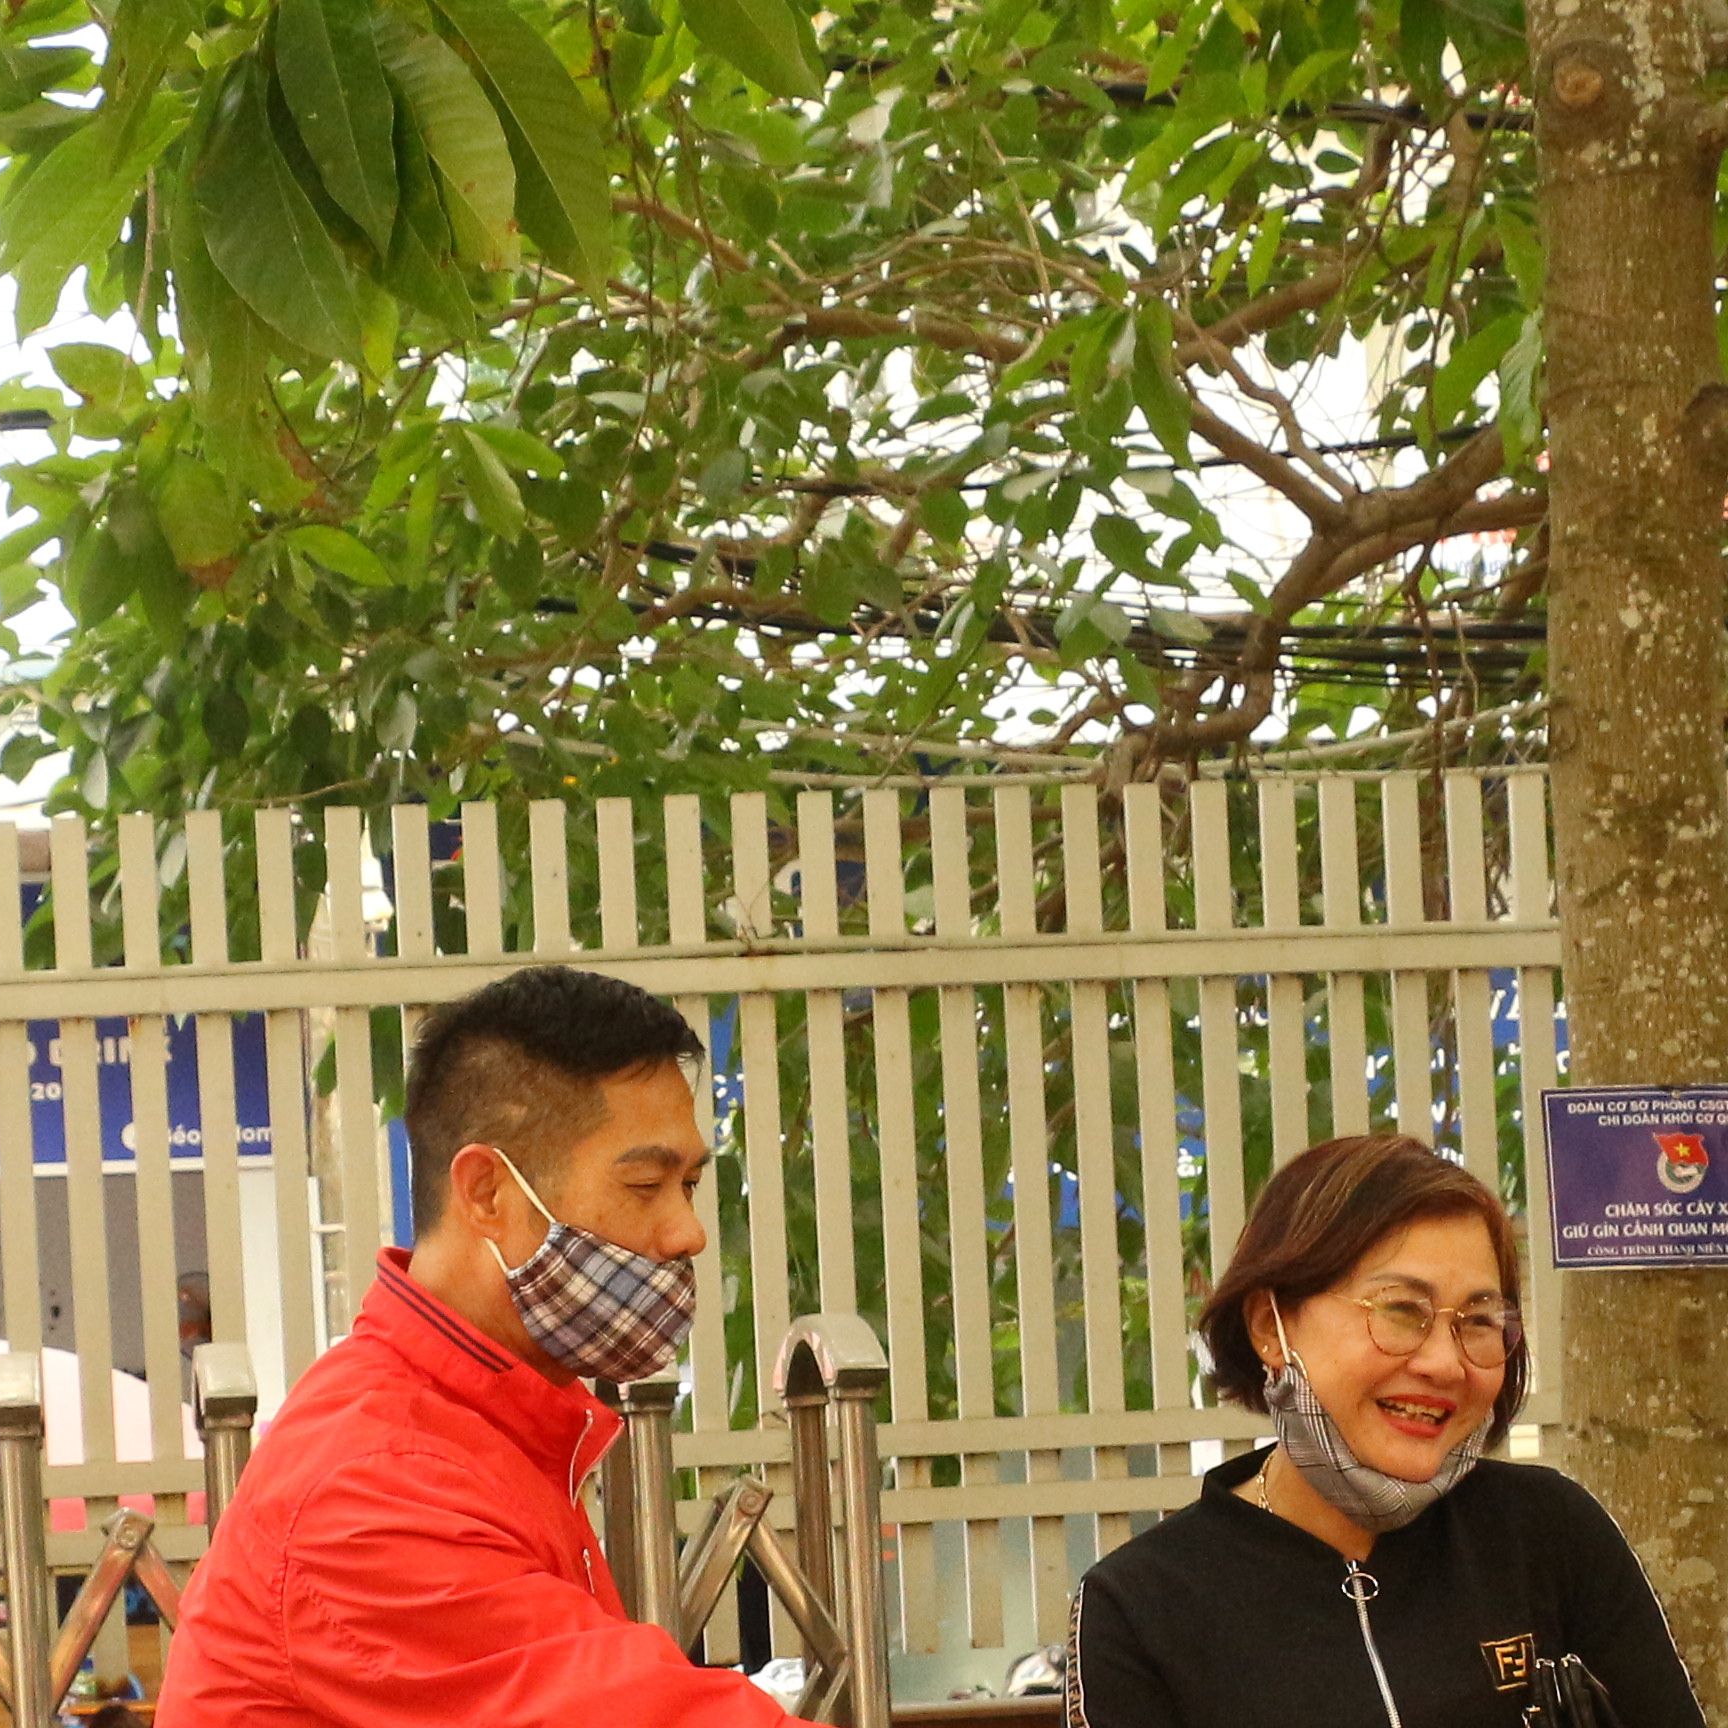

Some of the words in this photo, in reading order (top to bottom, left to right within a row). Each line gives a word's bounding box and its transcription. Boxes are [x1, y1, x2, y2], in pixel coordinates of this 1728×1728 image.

[1568, 1100, 1604, 1114] ĐOÀN
[1598, 1113, 1620, 1126] CHI
[1622, 1111, 1660, 1125] ĐOÀN
[1605, 1200, 1650, 1218] CHĂM
[1653, 1199, 1683, 1216] SÓC
[1686, 1199, 1715, 1215] CÂY
[1592, 1220, 1620, 1238] GÌN
[1623, 1219, 1664, 1236] CẢNH
[1667, 1222, 1708, 1236] QUAN
[1587, 1243, 1619, 1256] CÔNG
[1622, 1243, 1656, 1255] TRÌNH
[1659, 1244, 1695, 1255] THANH
[1697, 1241, 1723, 1254] NIÊN
